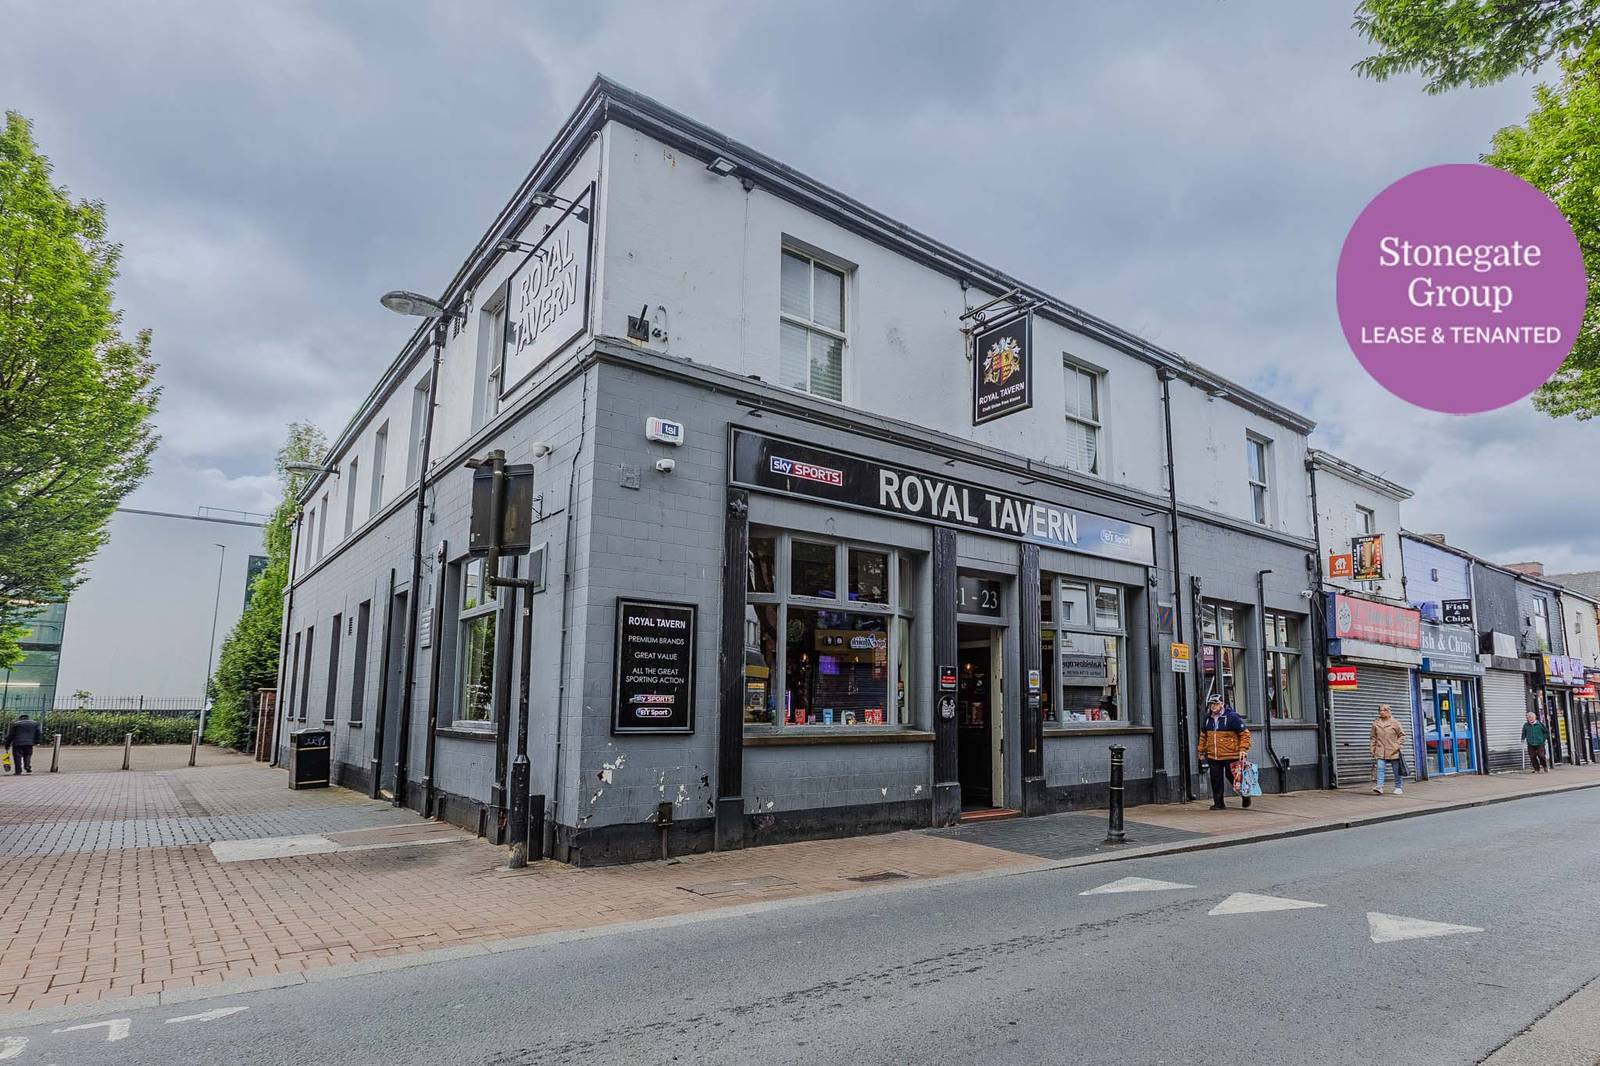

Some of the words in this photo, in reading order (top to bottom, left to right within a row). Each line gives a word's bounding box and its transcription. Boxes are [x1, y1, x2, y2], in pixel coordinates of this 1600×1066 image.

[520, 229, 574, 313] ROYAL
[513, 264, 579, 356] TAVERN
[978, 391, 999, 405] ROYAL
[1000, 382, 1025, 397] TAVERN
[773, 459, 792, 474] sky
[795, 464, 839, 483] SPORTS
[879, 468, 979, 525] ROYAL
[985, 493, 1078, 545] TAVERN
[981, 589, 998, 609] 23
[628, 616, 655, 627] ROYAL
[656, 618, 686, 629] TAVERN
[628, 635, 658, 644] PREMIUM
[659, 637, 685, 646] BRANDS
[1448, 634, 1472, 656] Chips
[634, 651, 656, 659] GREAT
[656, 652, 678, 660] VALUE
[625, 675, 658, 683] SPORTING
[645, 667, 656, 675] THE
